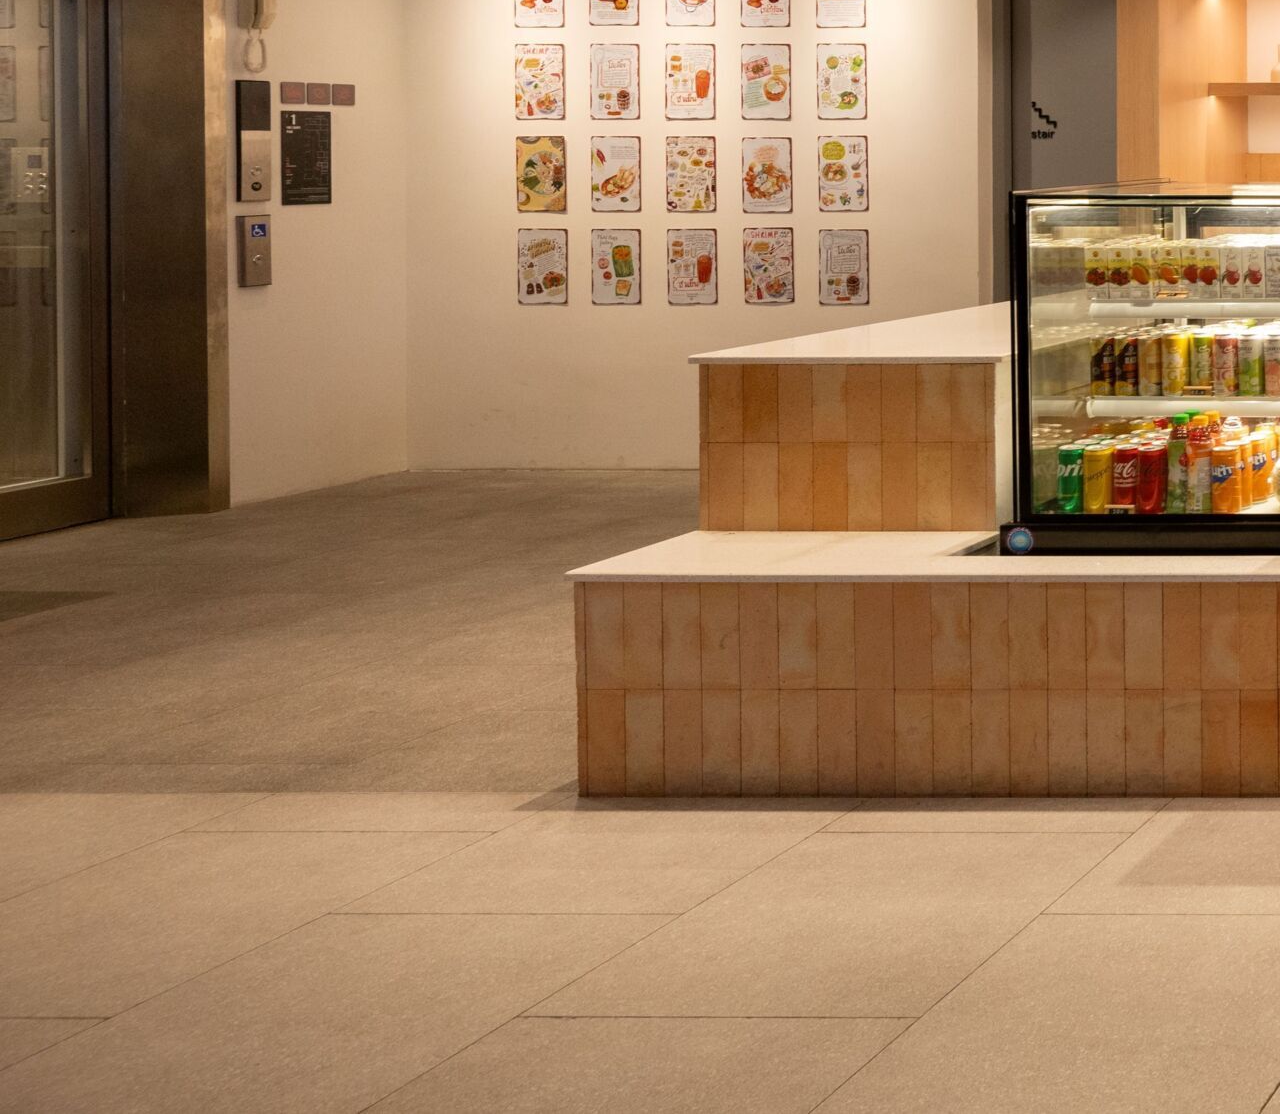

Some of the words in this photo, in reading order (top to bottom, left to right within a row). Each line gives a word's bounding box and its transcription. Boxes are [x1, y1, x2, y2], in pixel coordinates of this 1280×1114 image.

[522, 47, 549, 55] SHRIMP
[290, 113, 297, 125] 1
[1031, 129, 1055, 139] stair
